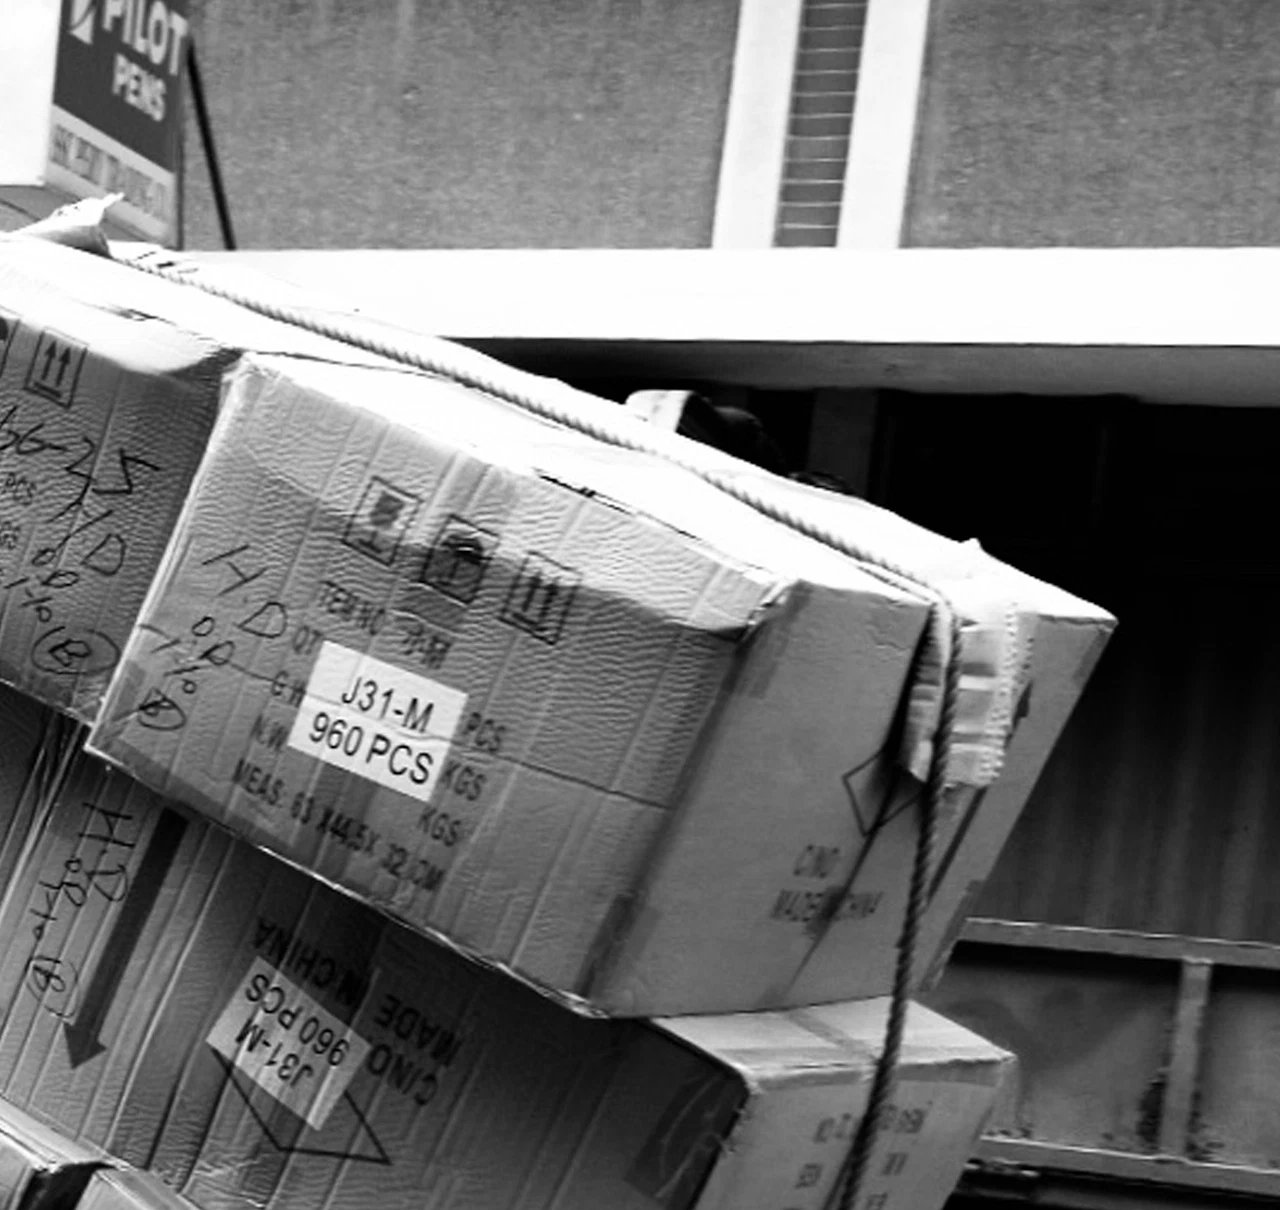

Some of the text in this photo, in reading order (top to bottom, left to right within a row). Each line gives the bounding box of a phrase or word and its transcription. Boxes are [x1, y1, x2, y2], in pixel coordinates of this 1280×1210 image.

[101, 0, 189, 76] PILOT
[341, 676, 434, 734] J31-M
[462, 711, 507, 753] PCS
[309, 711, 434, 785] 960 PCS
[441, 758, 488, 802] KGS
[418, 805, 463, 848] KGS
[252, 917, 337, 989] CHINA
[235, 1018, 315, 1087] J31-M
[245, 973, 350, 1067] 960 PCS
[373, 993, 463, 1068] MADE
